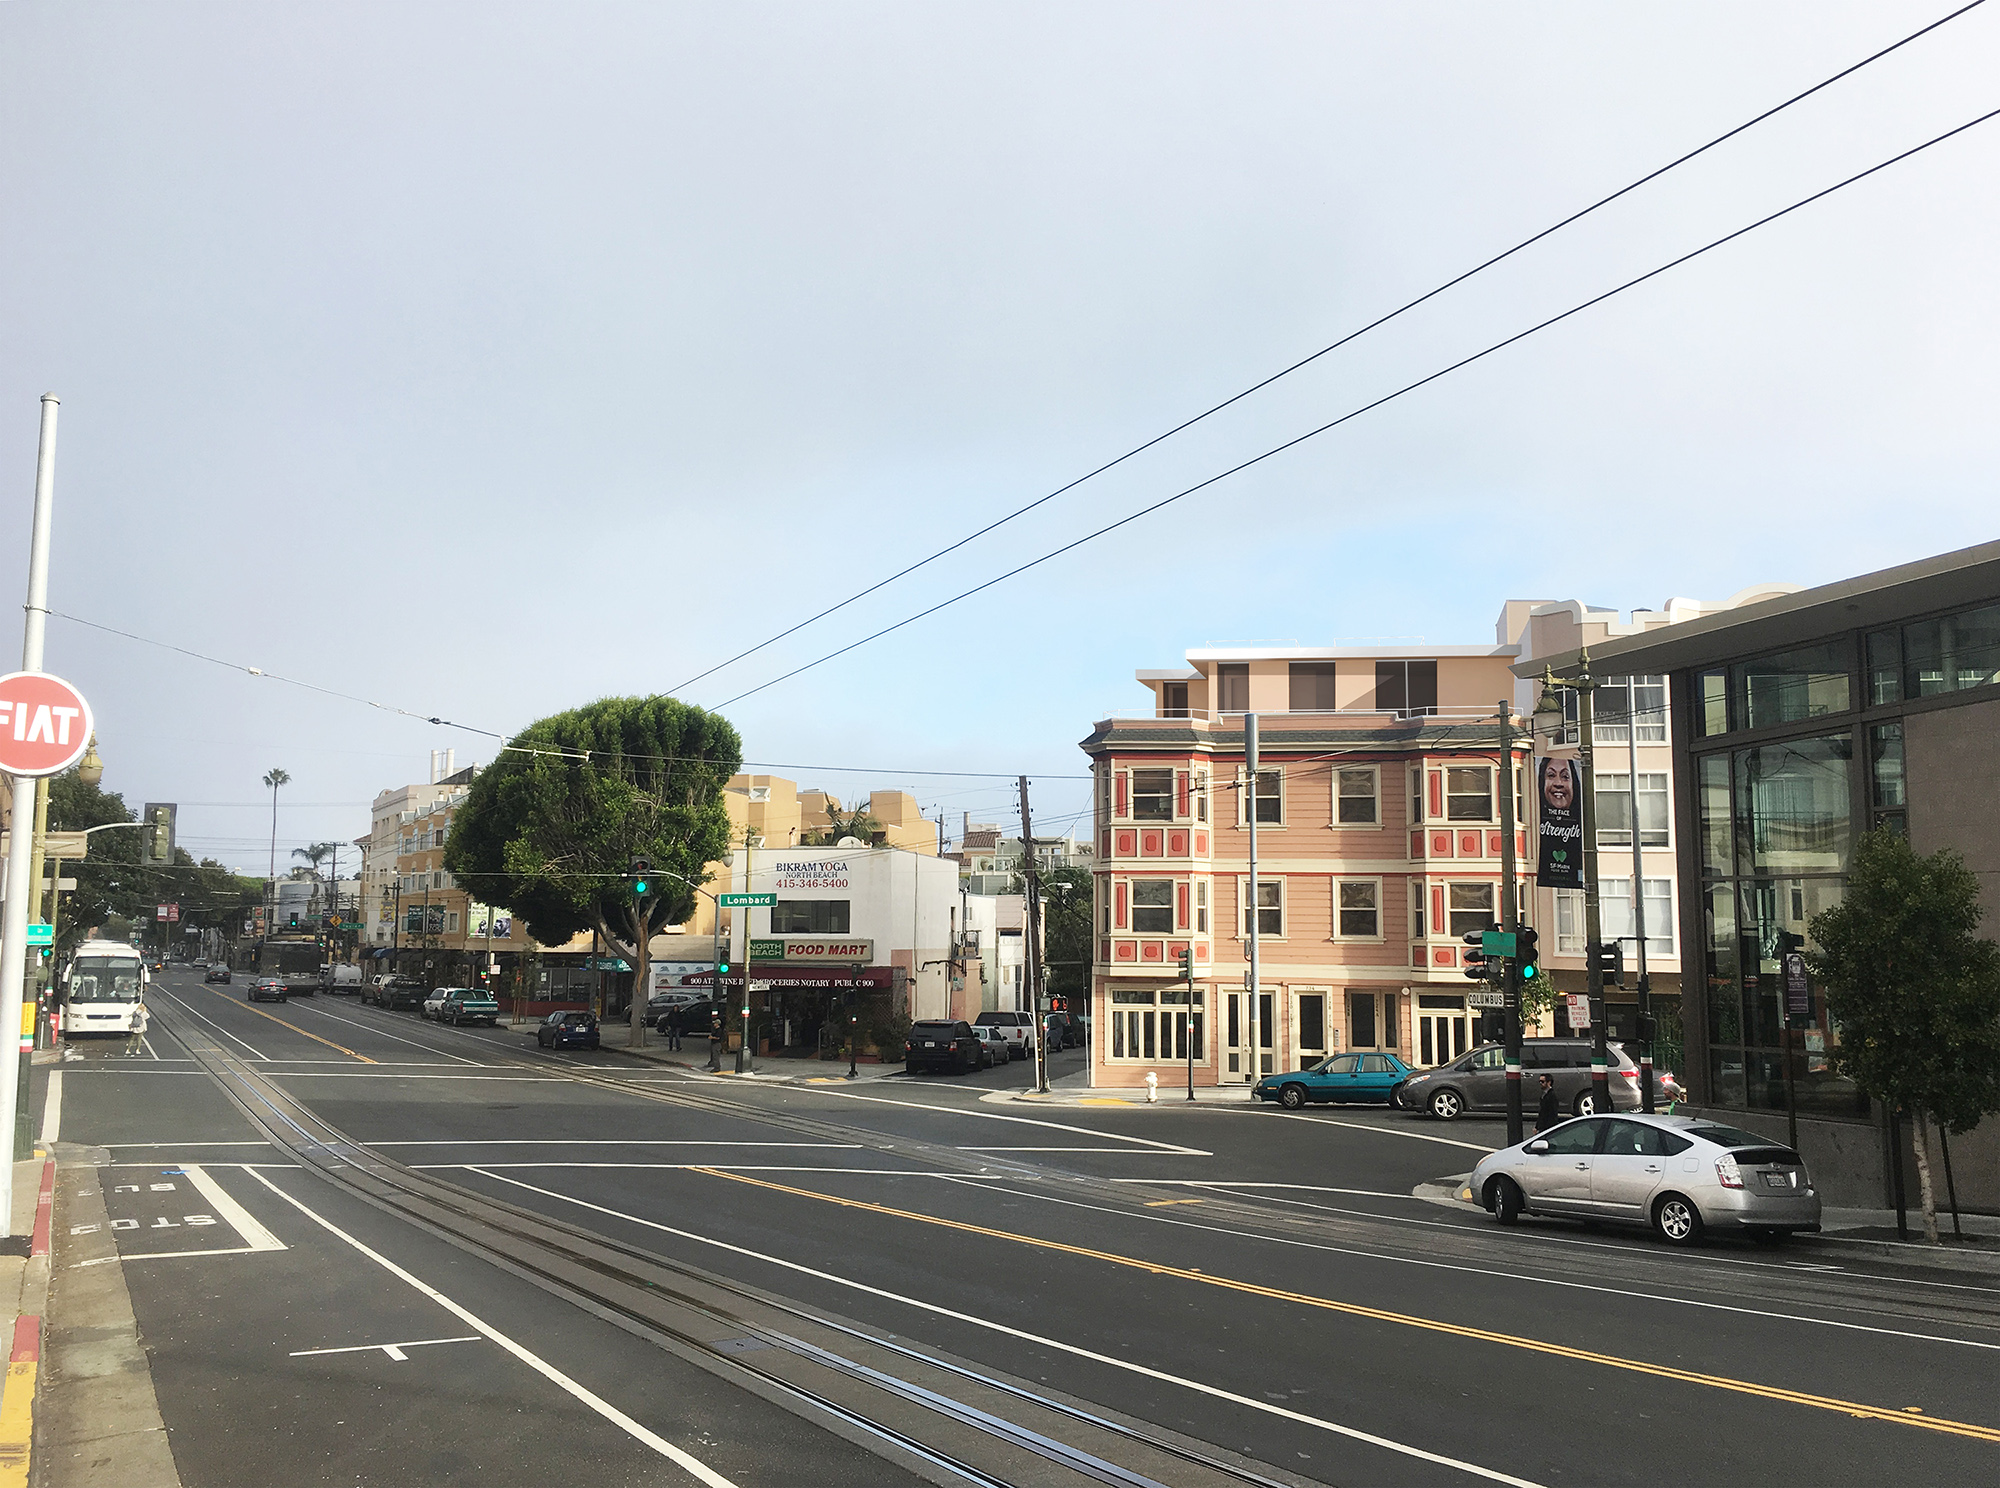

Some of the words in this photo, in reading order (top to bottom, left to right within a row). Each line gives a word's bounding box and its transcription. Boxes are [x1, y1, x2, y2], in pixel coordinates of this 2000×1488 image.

[1540, 821, 1581, 843] Strength
[776, 862, 816, 871] BIKRAM
[819, 862, 848, 871] YOGA
[776, 879, 848, 888] 415-346-5400
[727, 896, 770, 905] Lombard
[787, 945, 825, 955] FOOD
[828, 945, 867, 955] MART
[690, 977, 702, 985] 900
[719, 977, 738, 985] WINE
[801, 979, 830, 987] NOTARY
[834, 979, 861, 987] PUBLC
[1469, 994, 1503, 1005] COLUMBUS
[70, 1214, 218, 1236] STOP
